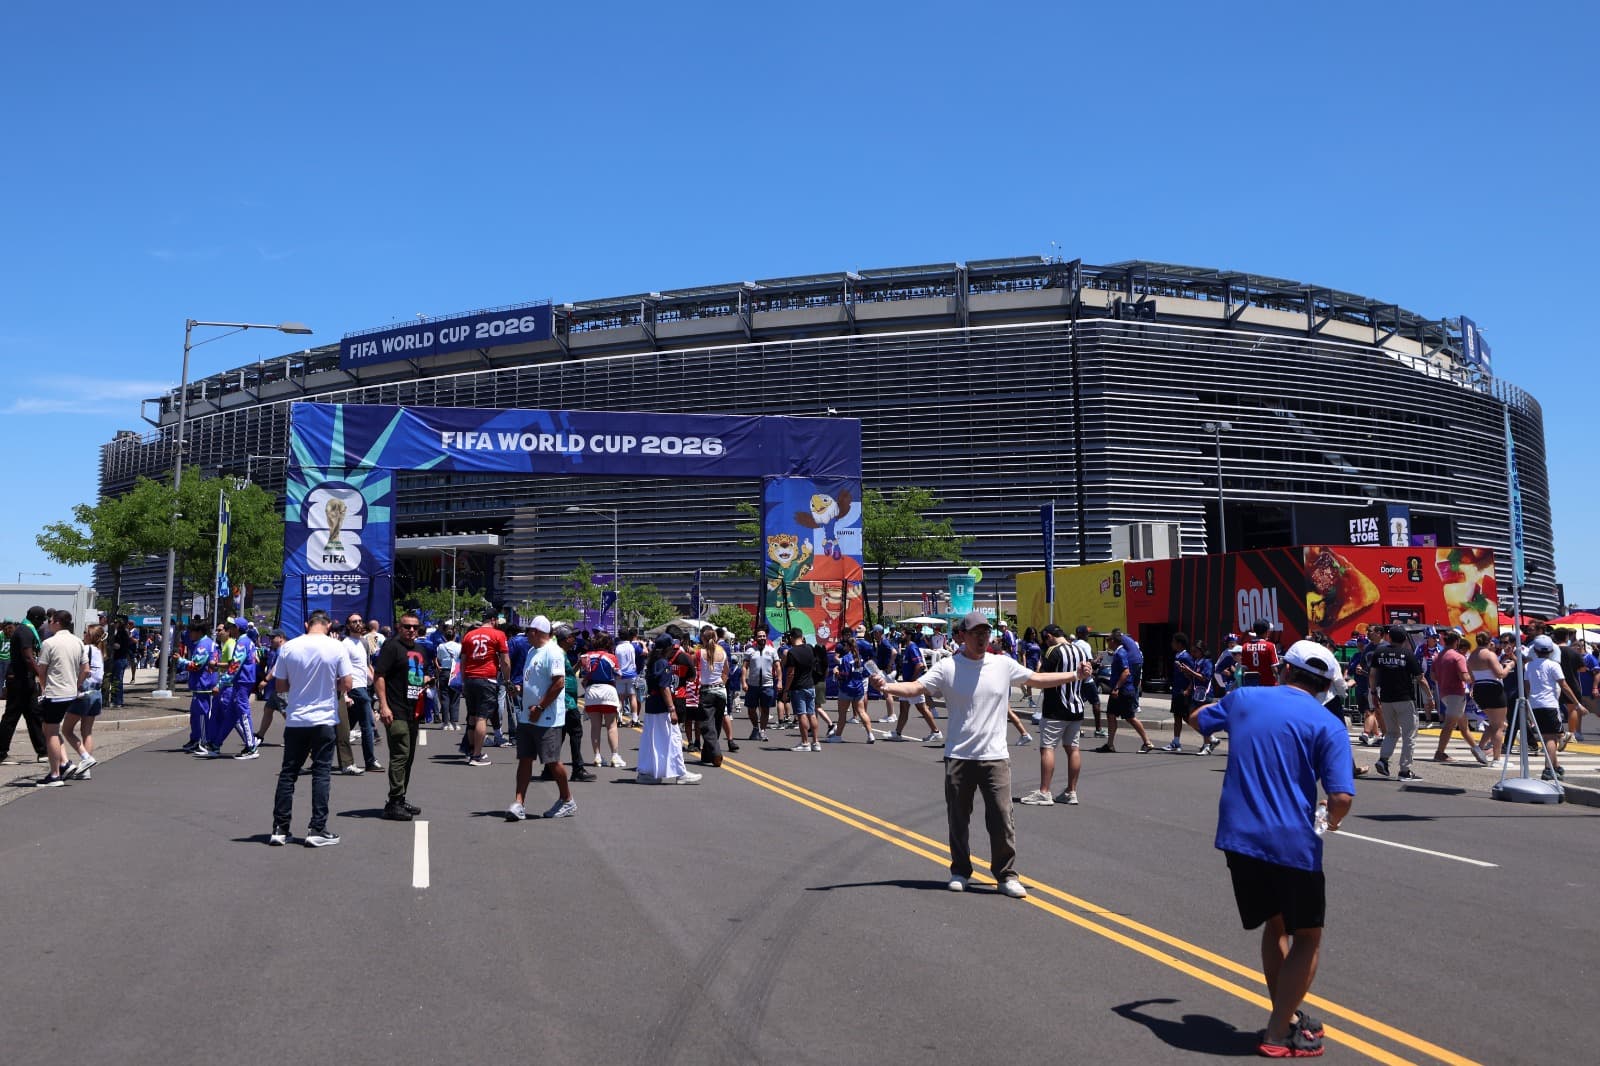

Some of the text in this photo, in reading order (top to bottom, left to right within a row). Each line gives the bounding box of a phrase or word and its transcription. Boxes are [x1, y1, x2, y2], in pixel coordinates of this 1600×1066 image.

[350, 315, 536, 360] FIFA WORLD CUP 2026
[441, 431, 724, 456] FIFA WORLD CUP 2026
[1349, 517, 1378, 533] FIFA
[1514, 496, 1522, 550] JERSEY
[1350, 532, 1379, 543] STORE
[322, 554, 347, 564] FIFA
[307, 574, 340, 582] WORLD
[307, 583, 361, 595] 2026
[1237, 587, 1284, 632] GOAL
[472, 639, 488, 659] 25
[1246, 643, 1267, 652] ERIC
[1252, 651, 1260, 667] 8
